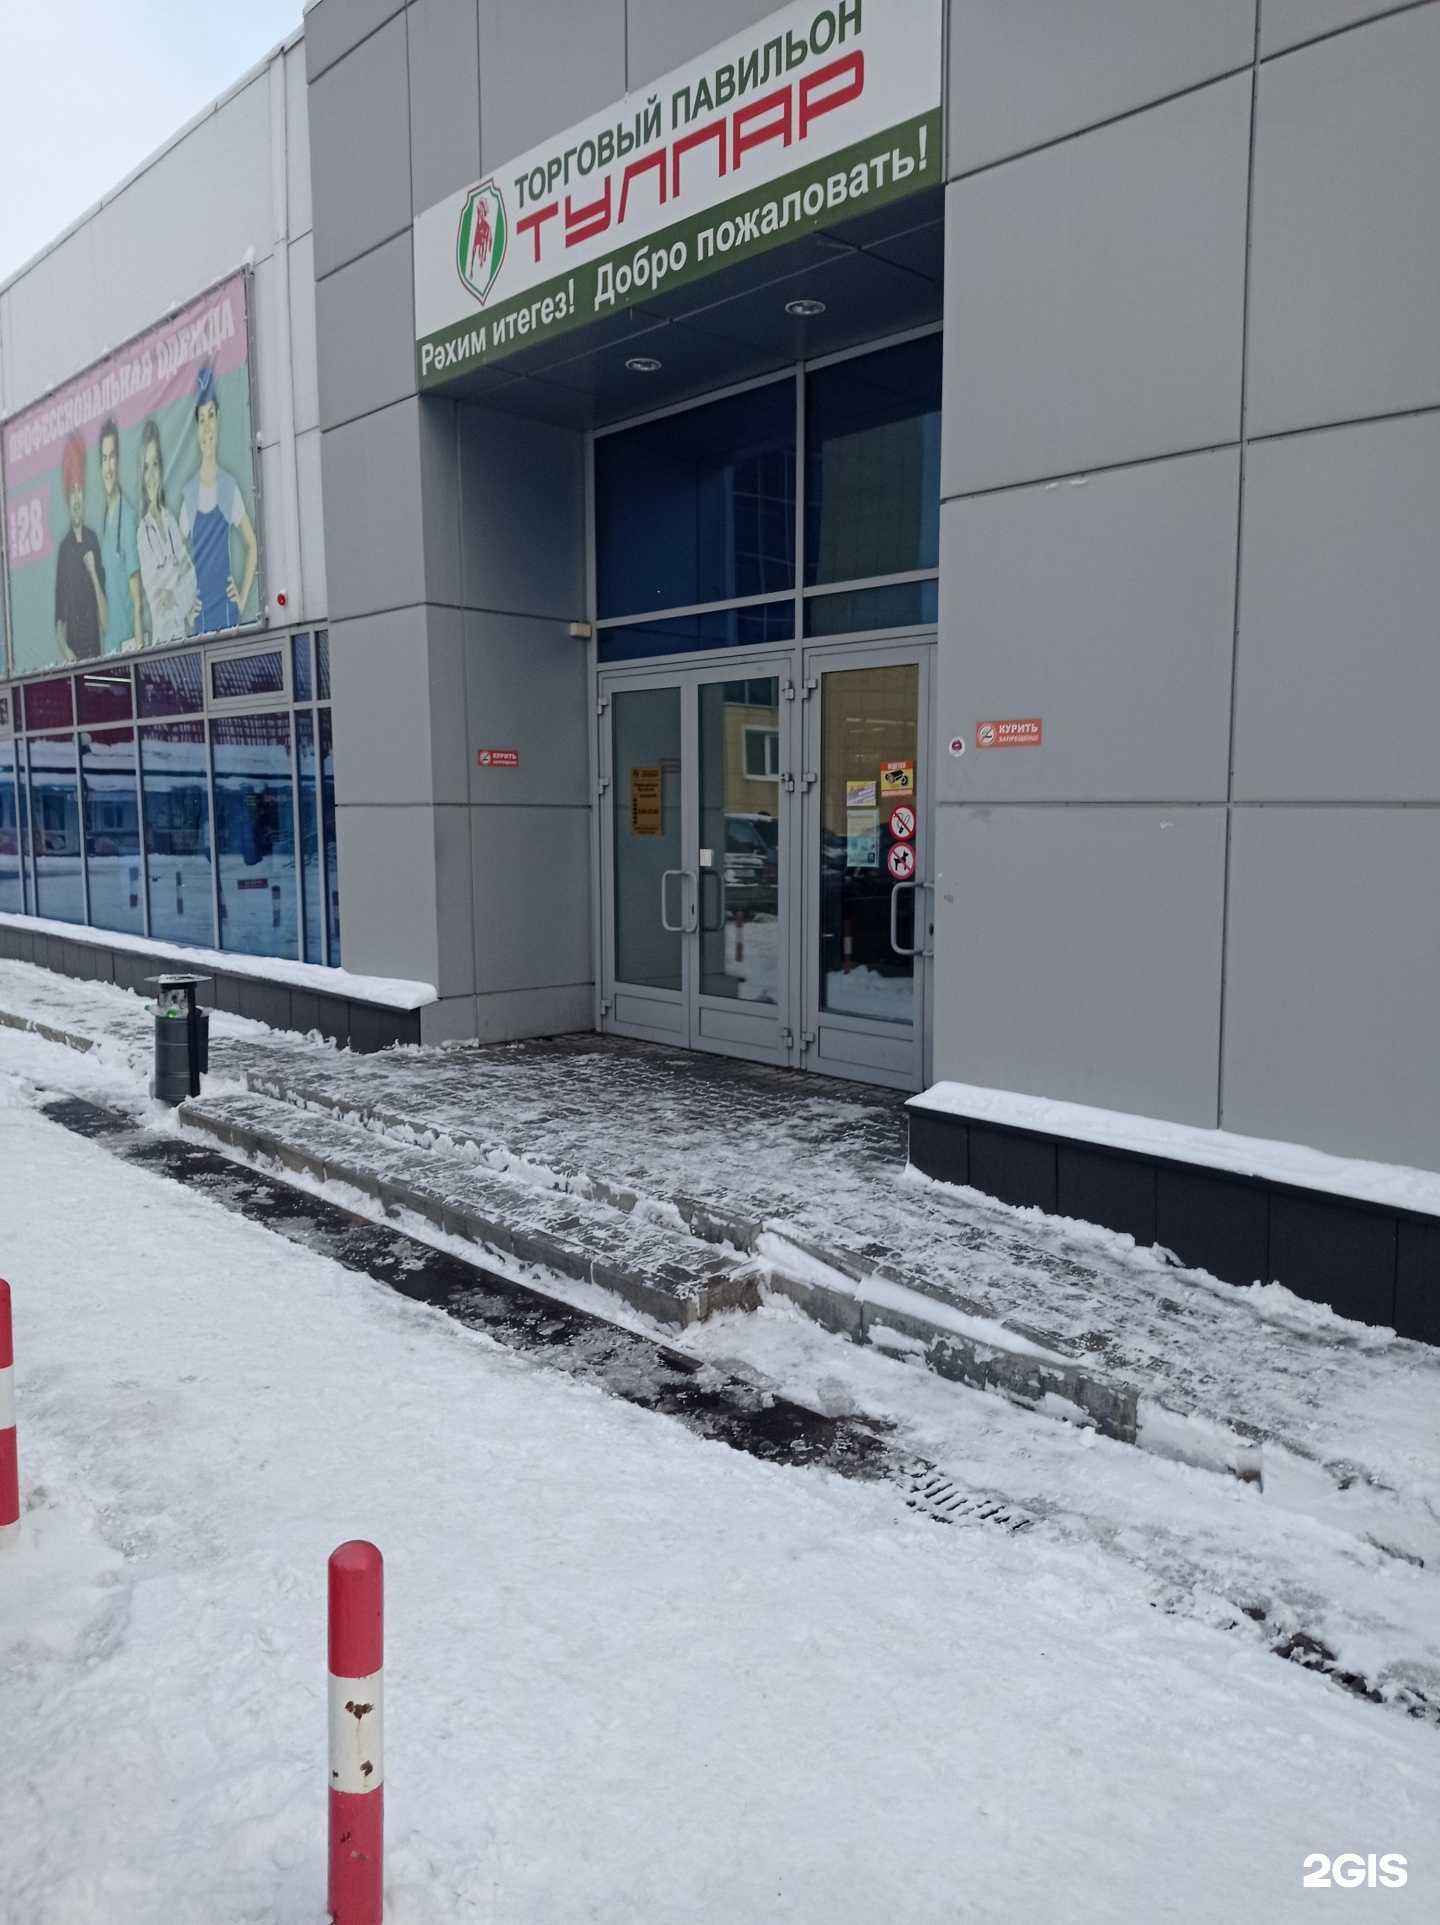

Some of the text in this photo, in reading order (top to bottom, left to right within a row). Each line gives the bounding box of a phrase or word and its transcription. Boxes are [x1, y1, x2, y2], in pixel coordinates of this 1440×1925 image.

[514, 0, 862, 209] ТОРГОВЫЙ ПАВИЛЬОН
[516, 49, 865, 263] ТУЛПАР
[421, 125, 928, 377] Рәхим итегез! Добро пожаловать!
[8, 298, 235, 463] ПРОФЕССИОНАЛЬНАЯ ОДЕЖДА
[998, 722, 1039, 734] КУРИТЬ
